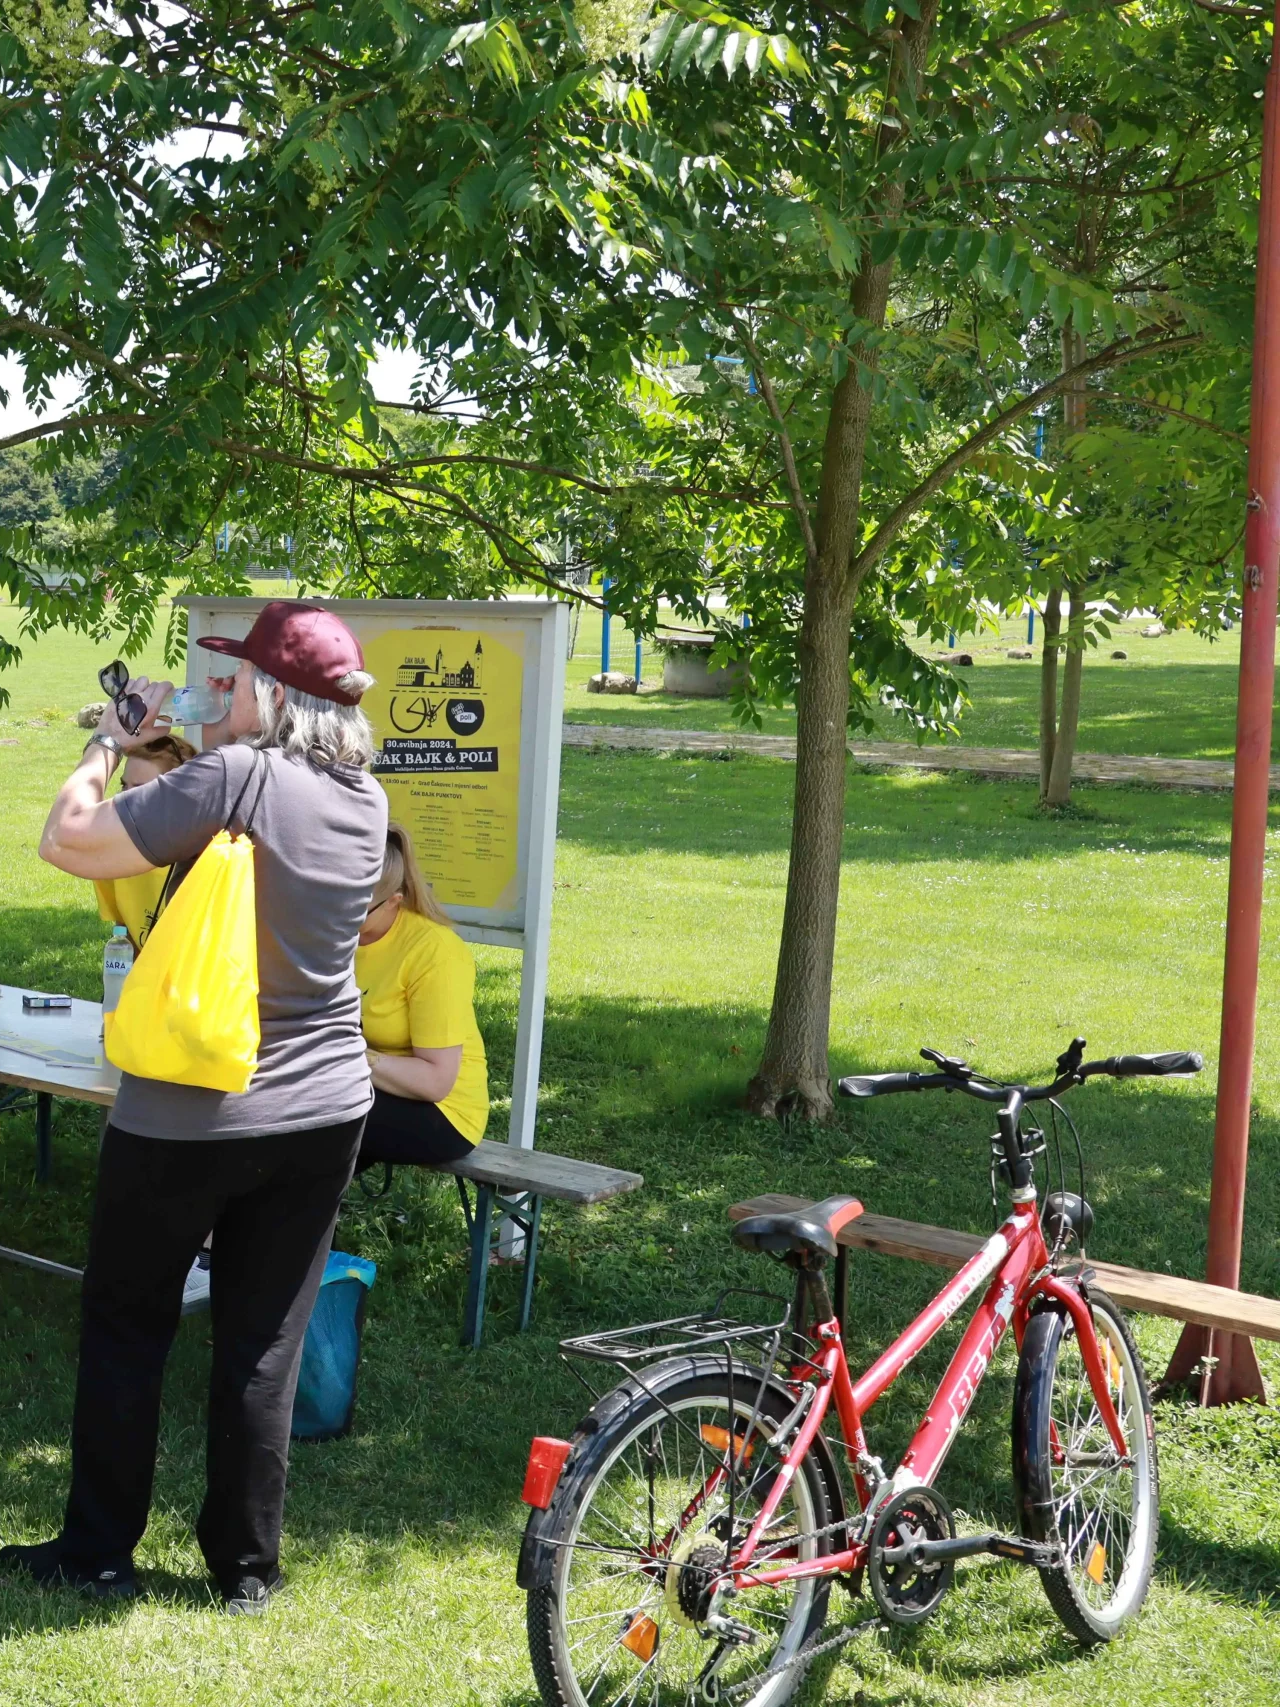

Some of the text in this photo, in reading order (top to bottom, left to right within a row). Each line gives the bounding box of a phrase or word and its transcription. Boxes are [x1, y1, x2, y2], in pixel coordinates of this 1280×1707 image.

[386, 740, 454, 750] 30.svibnja 2024.
[405, 752, 442, 764] BAJK
[445, 752, 456, 763] &
[459, 751, 493, 763] POLI
[431, 779, 451, 788] Čakovec
[435, 791, 463, 800] PUNKTOVI
[105, 960, 126, 970] SARA
[1147, 1439, 1156, 1480] Country
